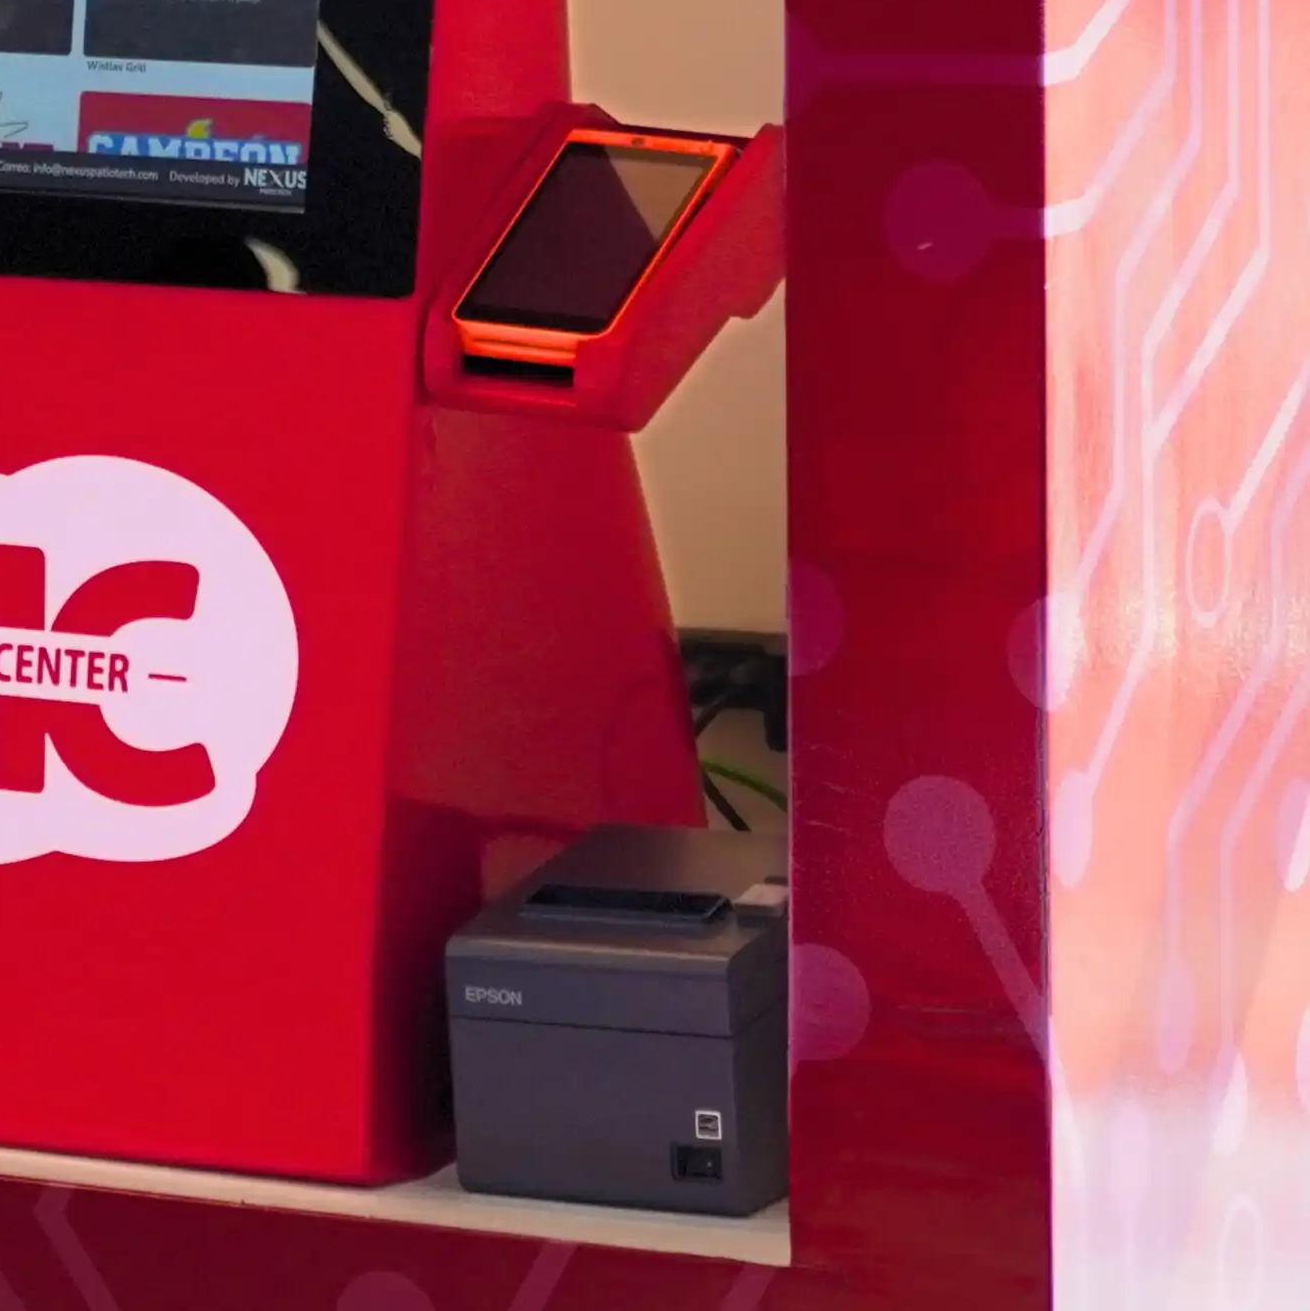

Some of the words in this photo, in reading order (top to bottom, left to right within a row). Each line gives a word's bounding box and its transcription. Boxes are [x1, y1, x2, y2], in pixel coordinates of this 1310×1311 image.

[169, 169, 225, 186] Developed
[227, 172, 240, 188] by
[243, 167, 307, 190] NEXUS
[465, 985, 522, 1006] EPSON
